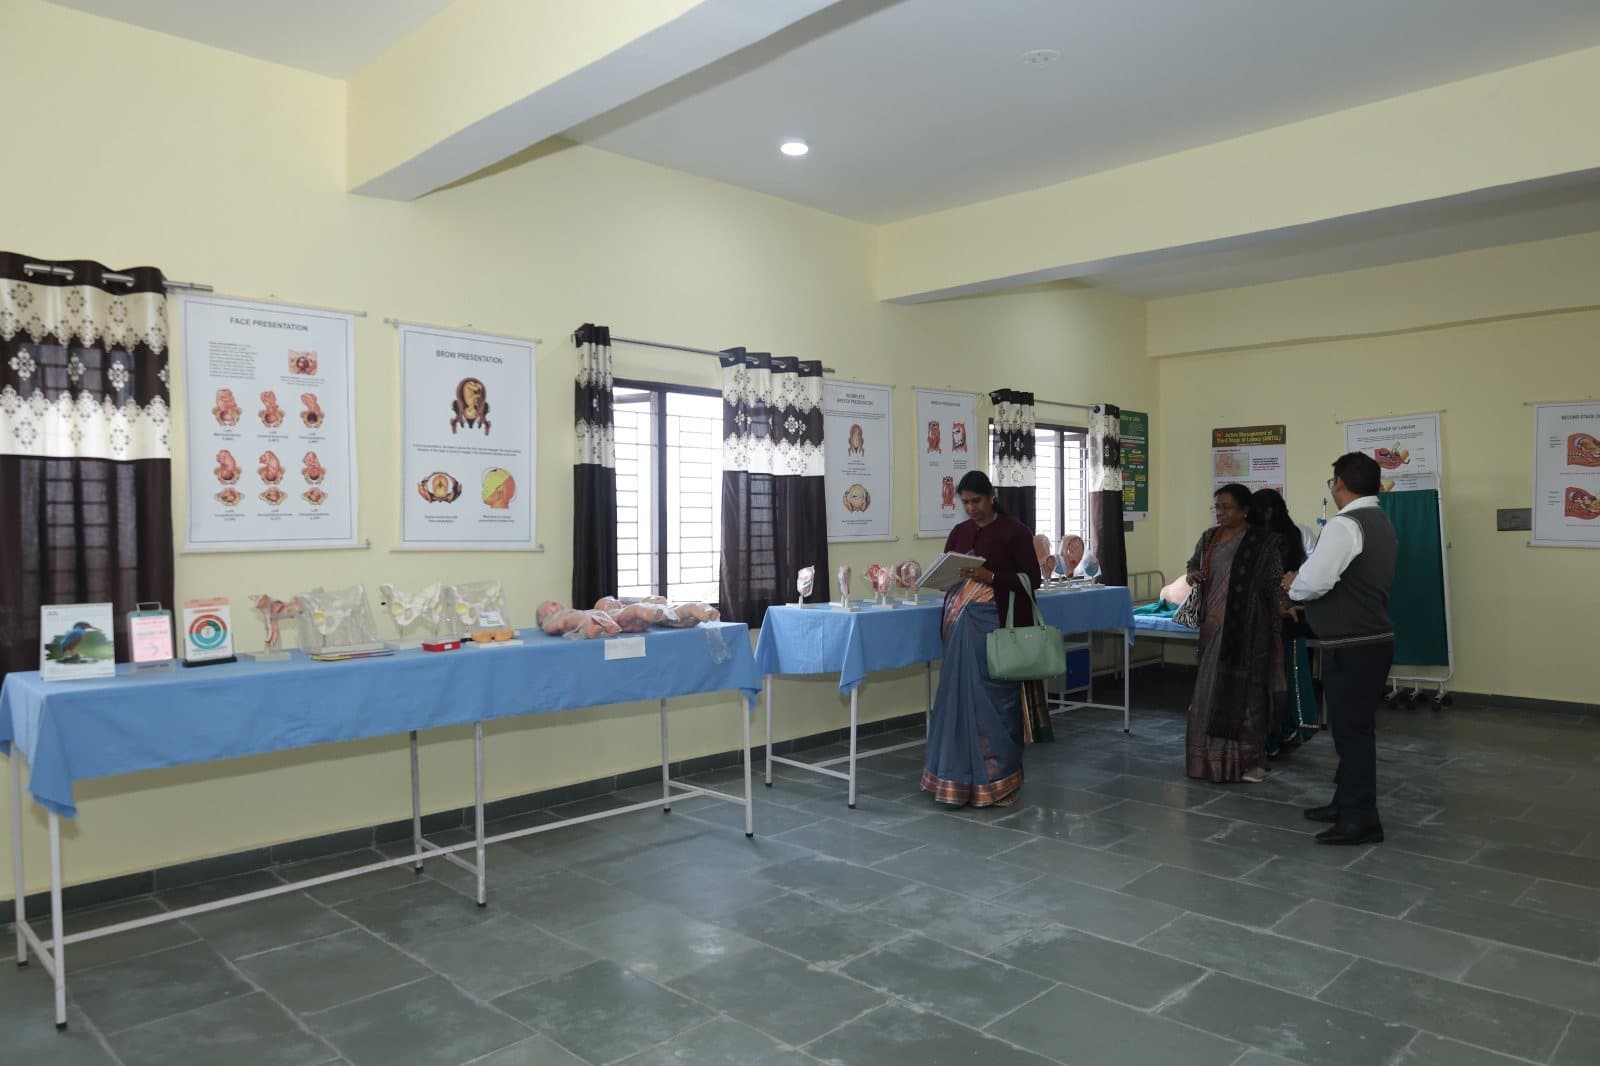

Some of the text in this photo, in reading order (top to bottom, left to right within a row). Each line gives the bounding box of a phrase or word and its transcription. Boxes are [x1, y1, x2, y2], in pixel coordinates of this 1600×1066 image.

[229, 317, 309, 332] FACE PRESENTATION
[436, 350, 503, 364] BROW PRESENTATION
